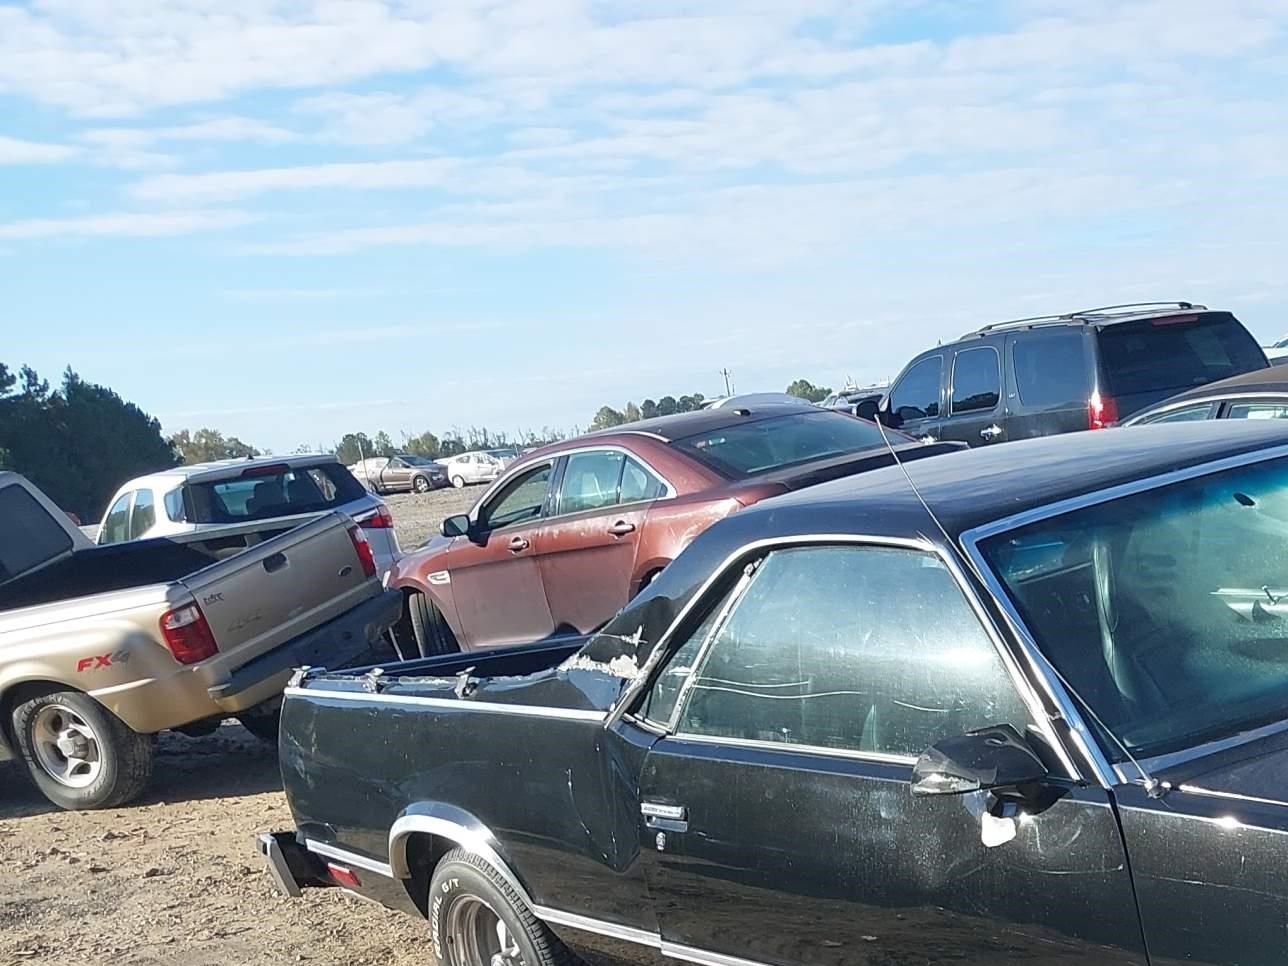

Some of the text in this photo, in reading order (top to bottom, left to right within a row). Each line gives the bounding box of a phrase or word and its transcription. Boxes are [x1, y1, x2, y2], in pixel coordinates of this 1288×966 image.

[77, 650, 130, 673] FX4
[432, 878, 459, 960] RADIAL G/T
